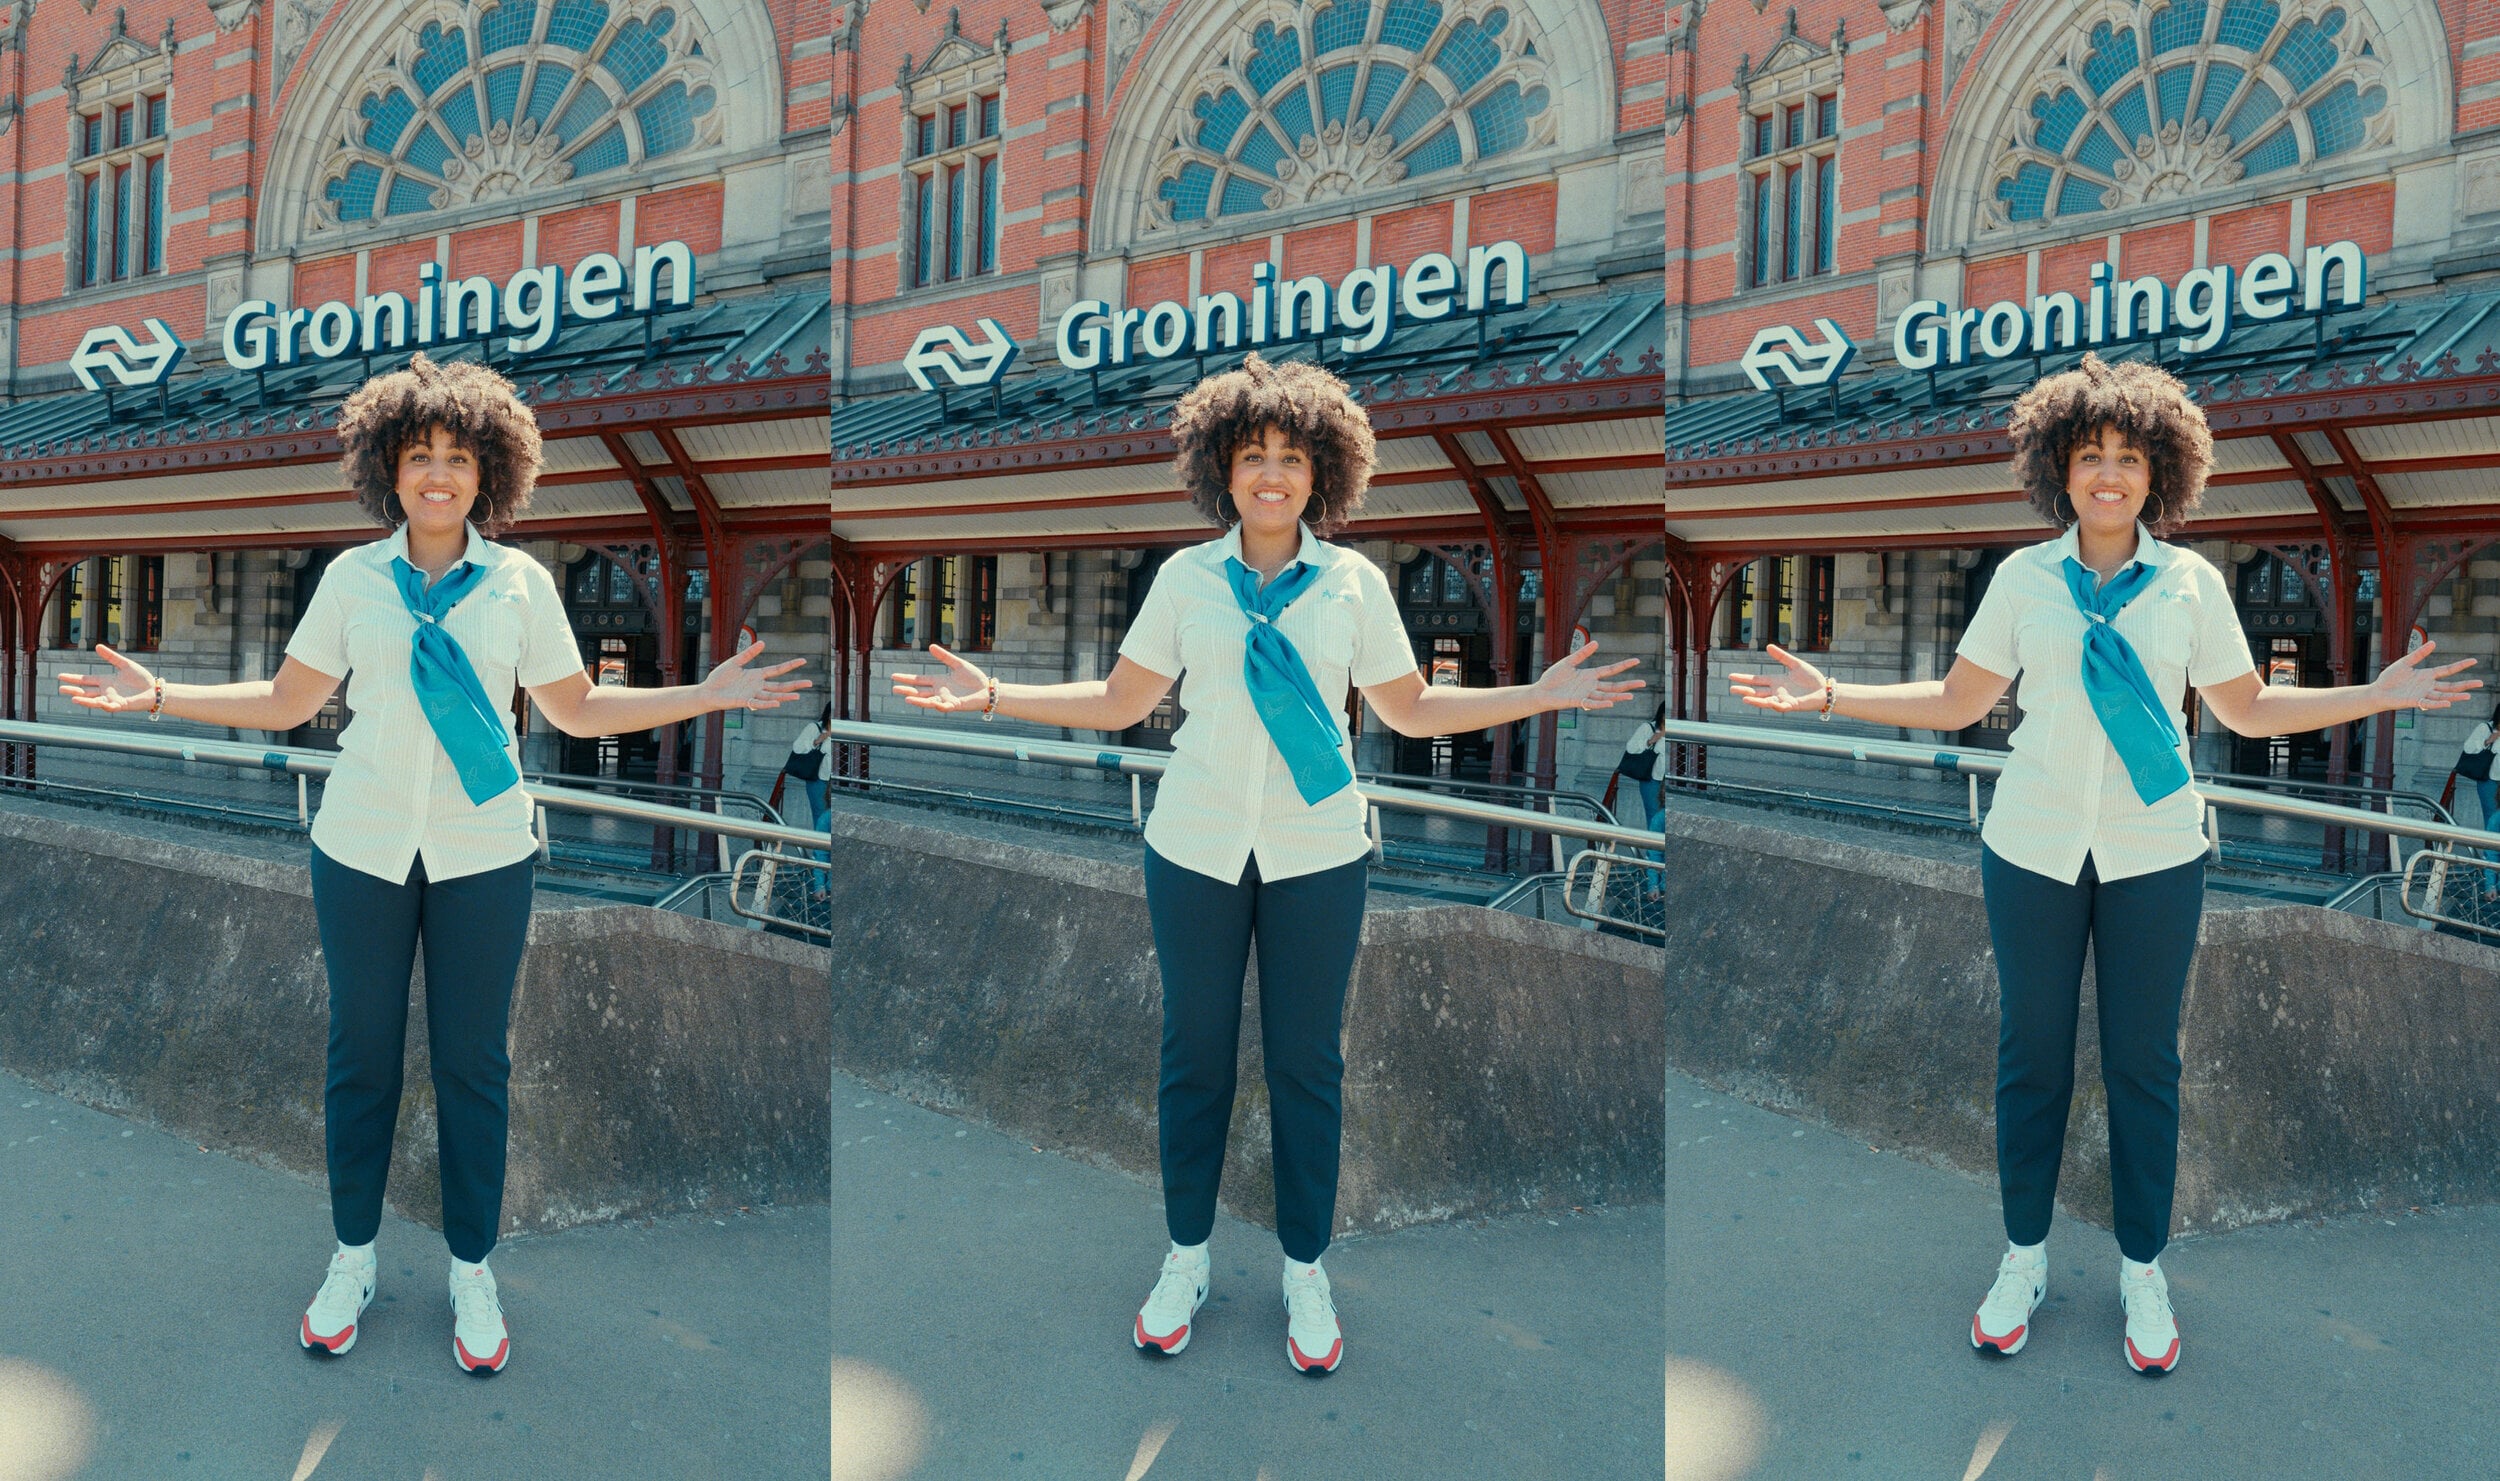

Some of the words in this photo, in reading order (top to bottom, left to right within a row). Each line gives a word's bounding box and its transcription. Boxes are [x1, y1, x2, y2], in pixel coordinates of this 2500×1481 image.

[223, 240, 693, 370] Groningen
[1056, 240, 1526, 370] Groningen
[1893, 240, 2363, 370] Groningen
